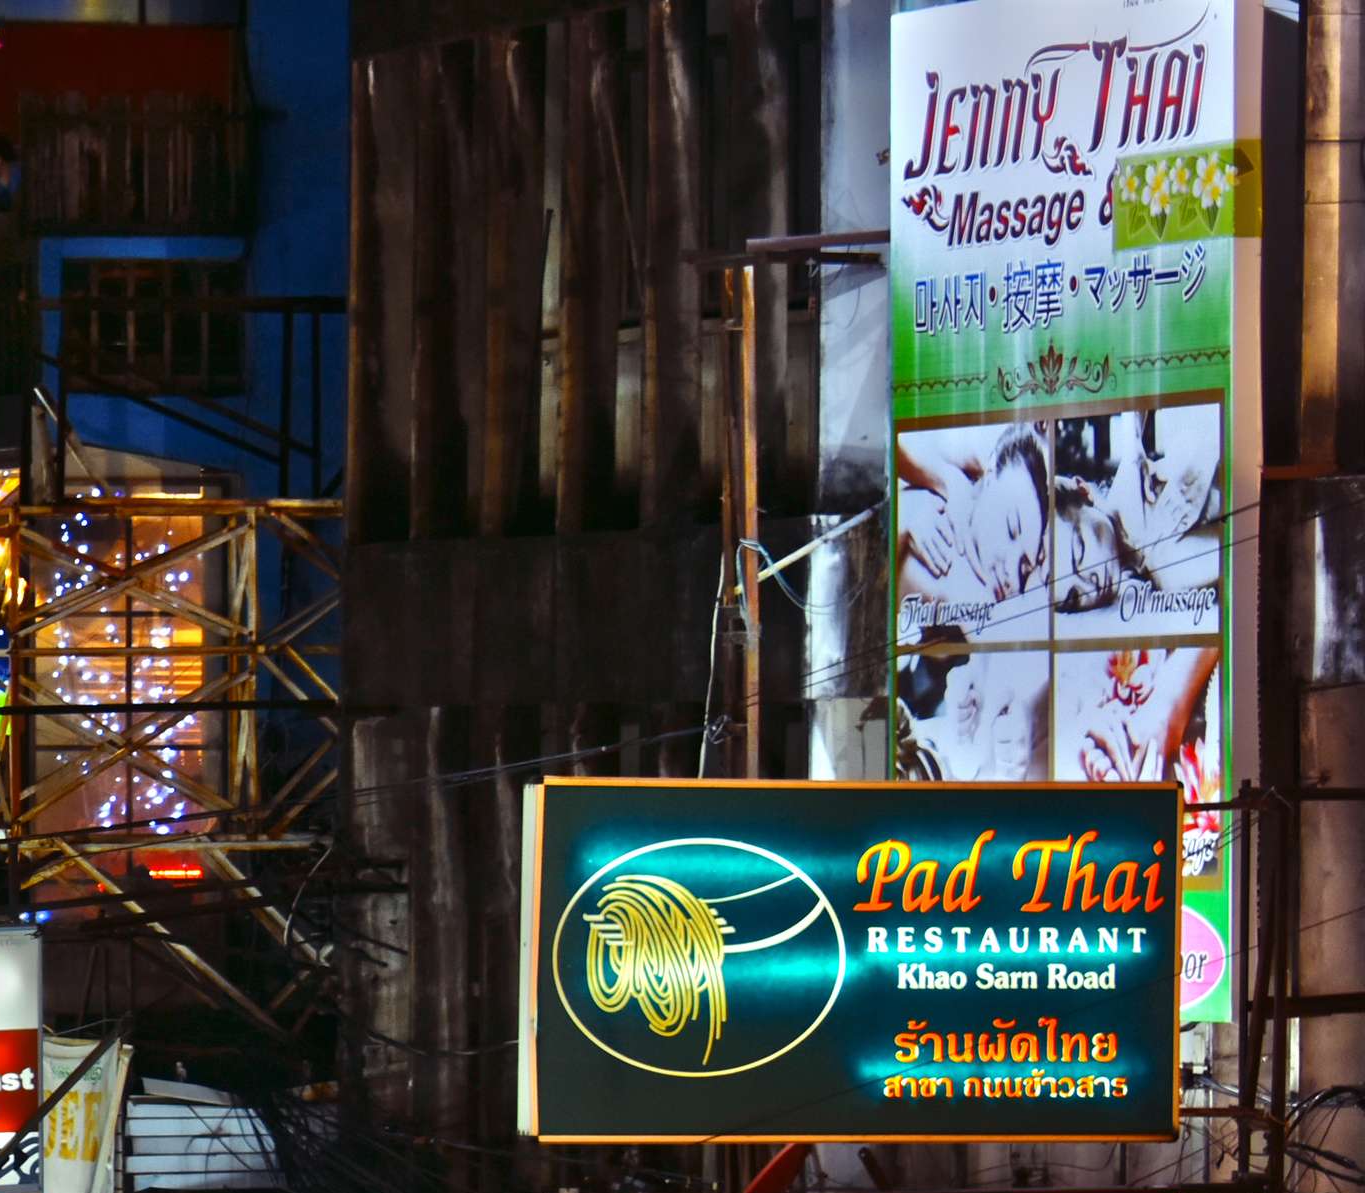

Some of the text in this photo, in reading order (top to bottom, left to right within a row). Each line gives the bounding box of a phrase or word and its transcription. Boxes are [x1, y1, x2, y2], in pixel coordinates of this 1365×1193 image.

[904, 36, 1209, 180] JENNY THAI
[947, 188, 1085, 247] Massage
[914, 270, 986, 334] 마사지
[1001, 258, 1064, 330] 按摩
[1084, 244, 1207, 312] マッサージ
[1150, 586, 1216, 625] massage
[852, 828, 998, 914] Pad
[1011, 830, 1165, 915] Thai
[866, 925, 1148, 955] RESTAURANT
[896, 960, 1117, 992] Khao Sarn Road
[893, 1017, 1119, 1065] ร้านผัดไทย
